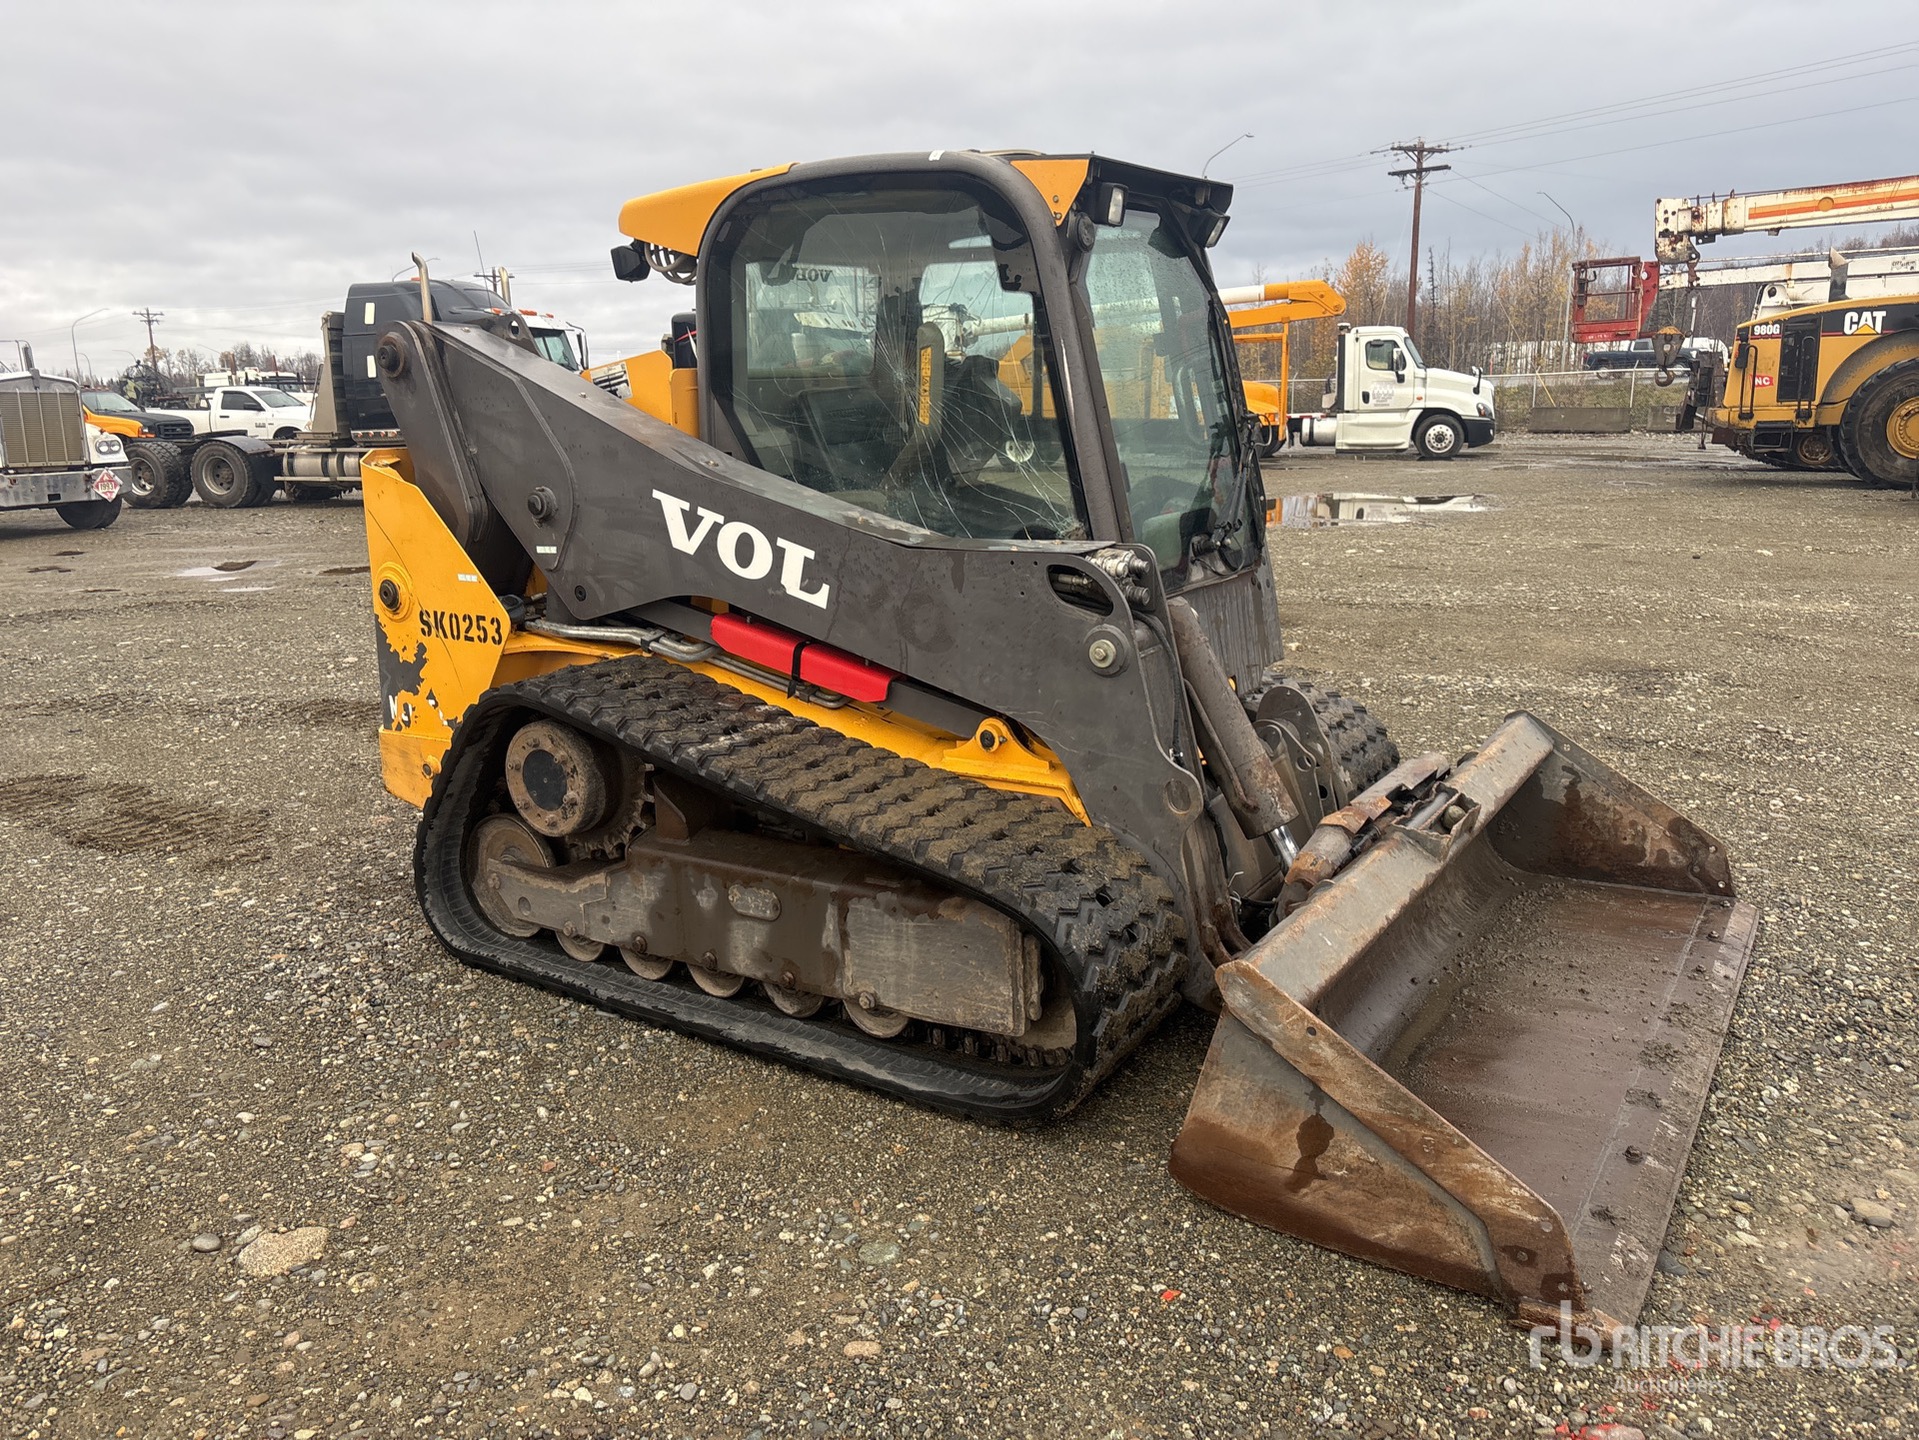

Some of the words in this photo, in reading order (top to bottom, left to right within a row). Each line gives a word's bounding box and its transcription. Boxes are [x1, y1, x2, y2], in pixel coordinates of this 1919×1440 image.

[1753, 323, 1781, 336] 980G
[1843, 310, 1887, 336] CAT
[652, 488, 830, 610] VOL
[419, 609, 503, 646] SK0253
